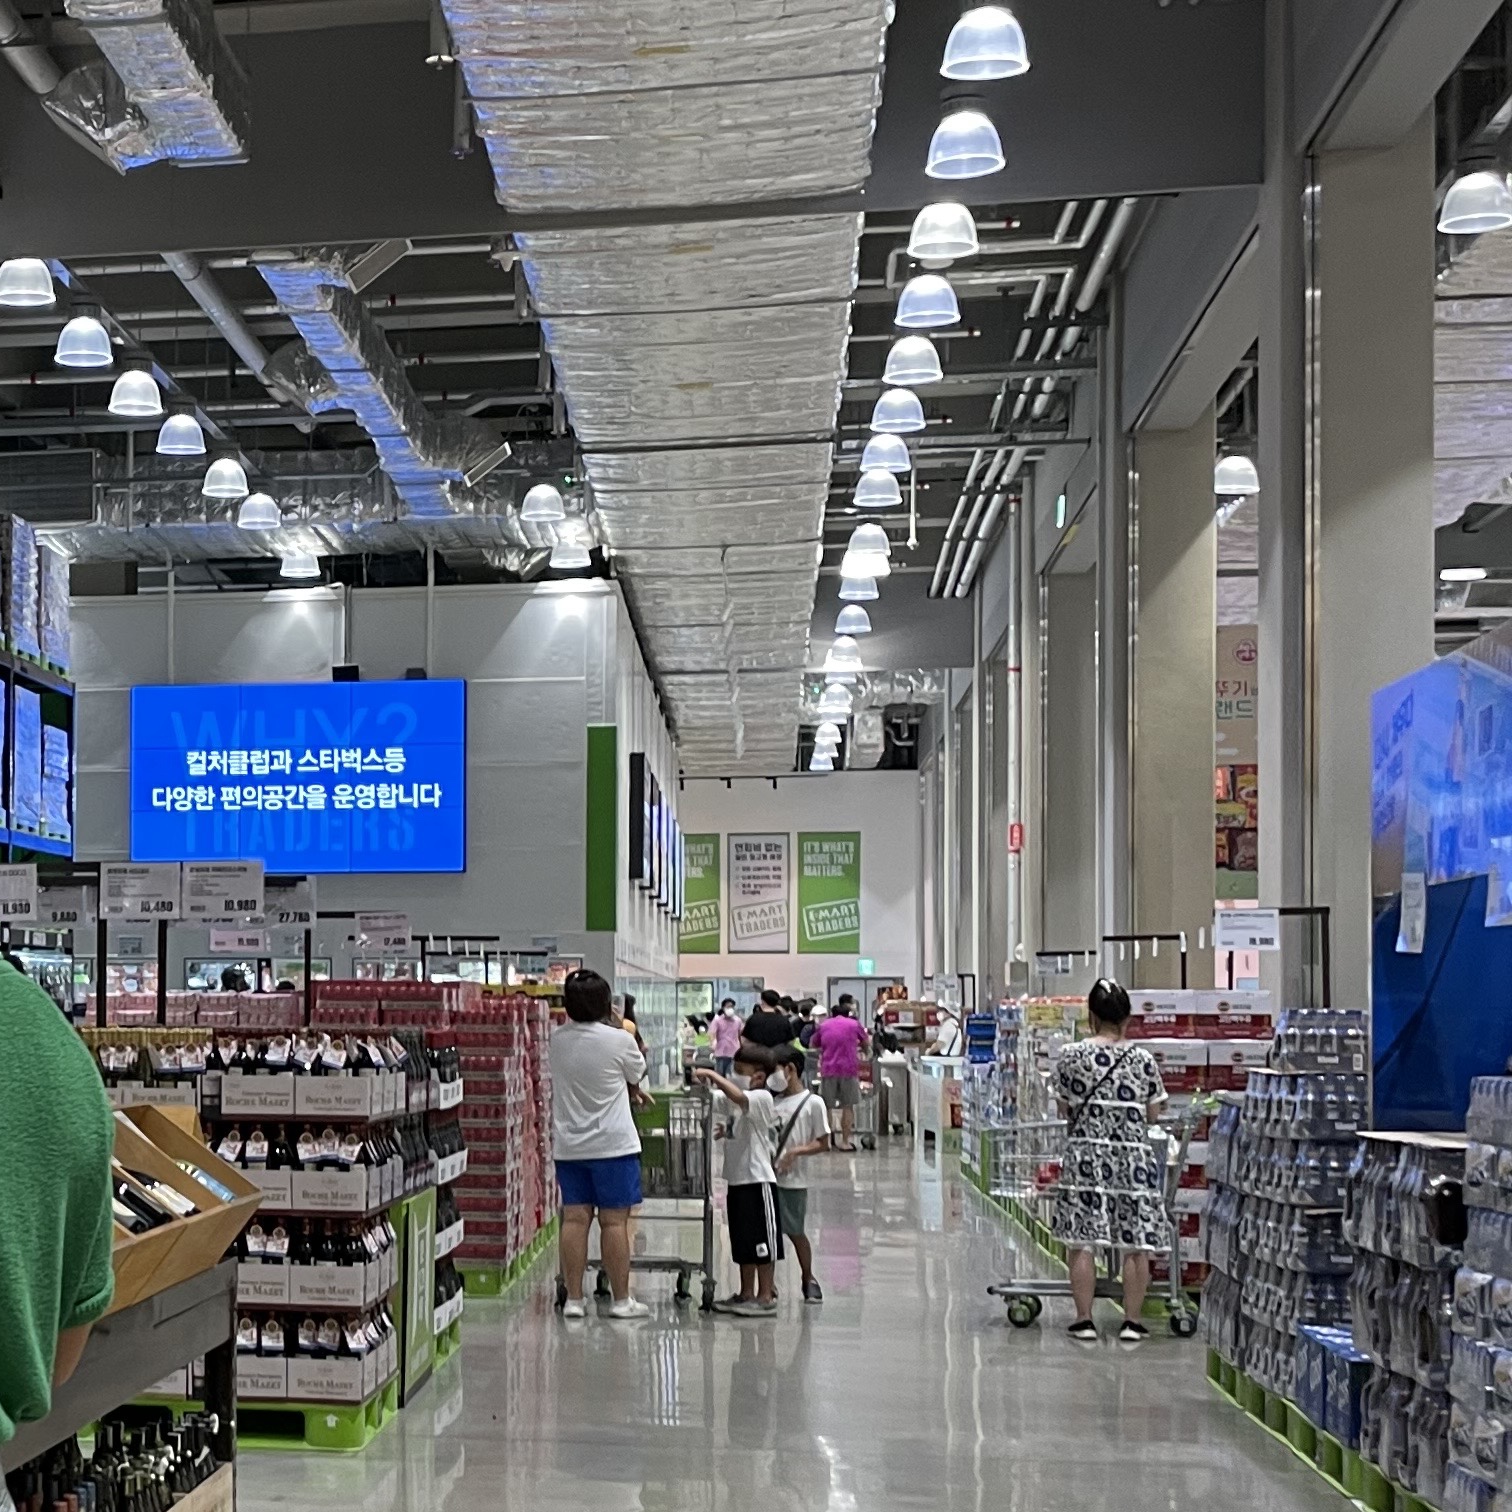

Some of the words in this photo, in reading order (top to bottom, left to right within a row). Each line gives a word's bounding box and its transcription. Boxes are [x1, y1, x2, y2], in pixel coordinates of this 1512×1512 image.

[1216, 680, 1248, 697] 뚜기
[1216, 700, 1253, 720] 랜드
[186, 749, 292, 776] 컬처클럽과
[152, 785, 215, 812] 다양한
[220, 783, 326, 811] 편의공간을
[332, 782, 442, 809] 운영합니다
[810, 916, 859, 935] TRADERS
